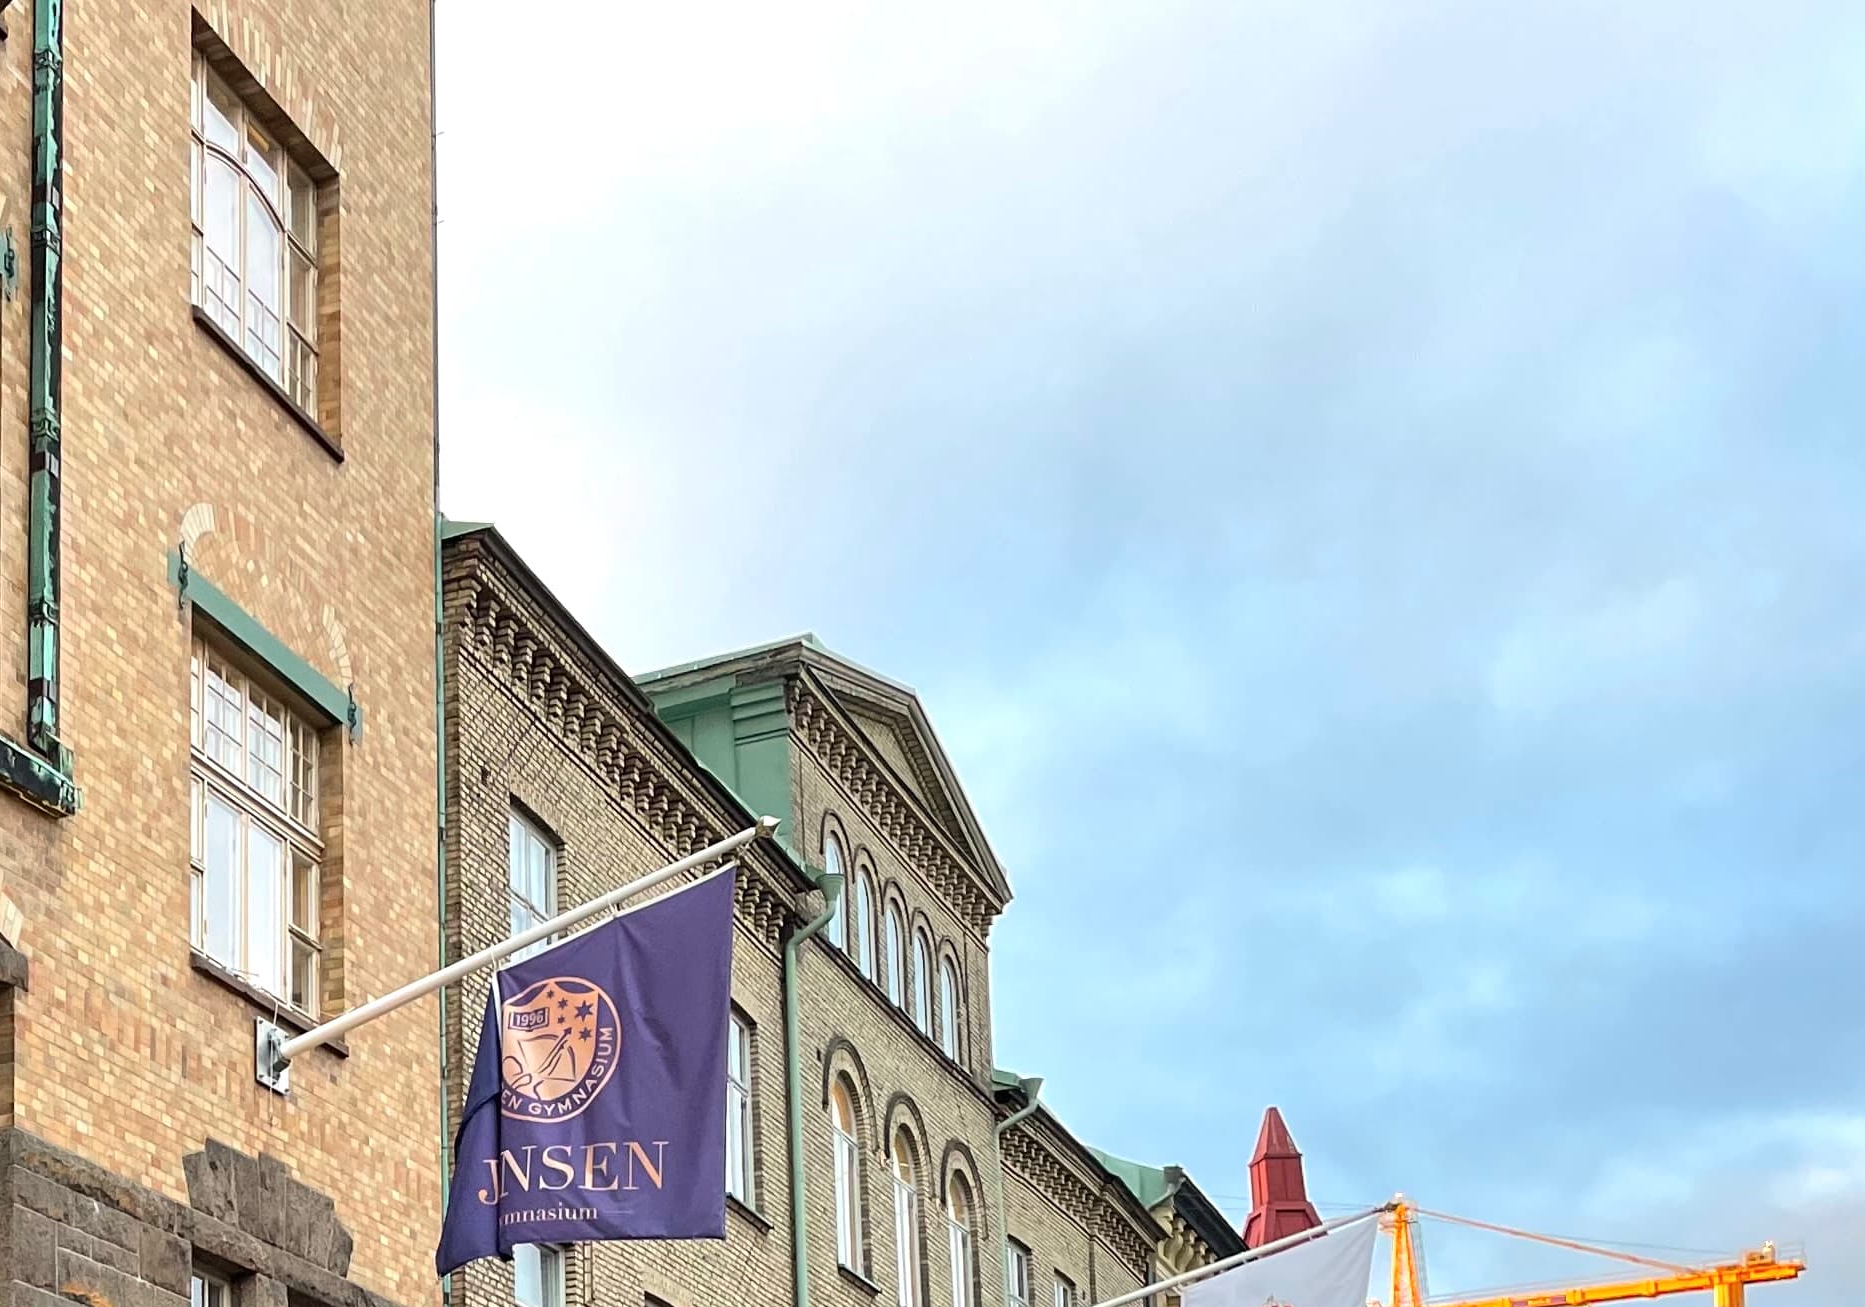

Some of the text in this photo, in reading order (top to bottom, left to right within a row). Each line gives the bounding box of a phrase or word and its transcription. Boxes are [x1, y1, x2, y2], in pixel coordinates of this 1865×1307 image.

[515, 1010, 544, 1027] 1996
[528, 1026, 614, 1116] GYMNASIUM
[477, 1140, 670, 1206] JNSEN
[500, 1201, 598, 1227] mnasium
